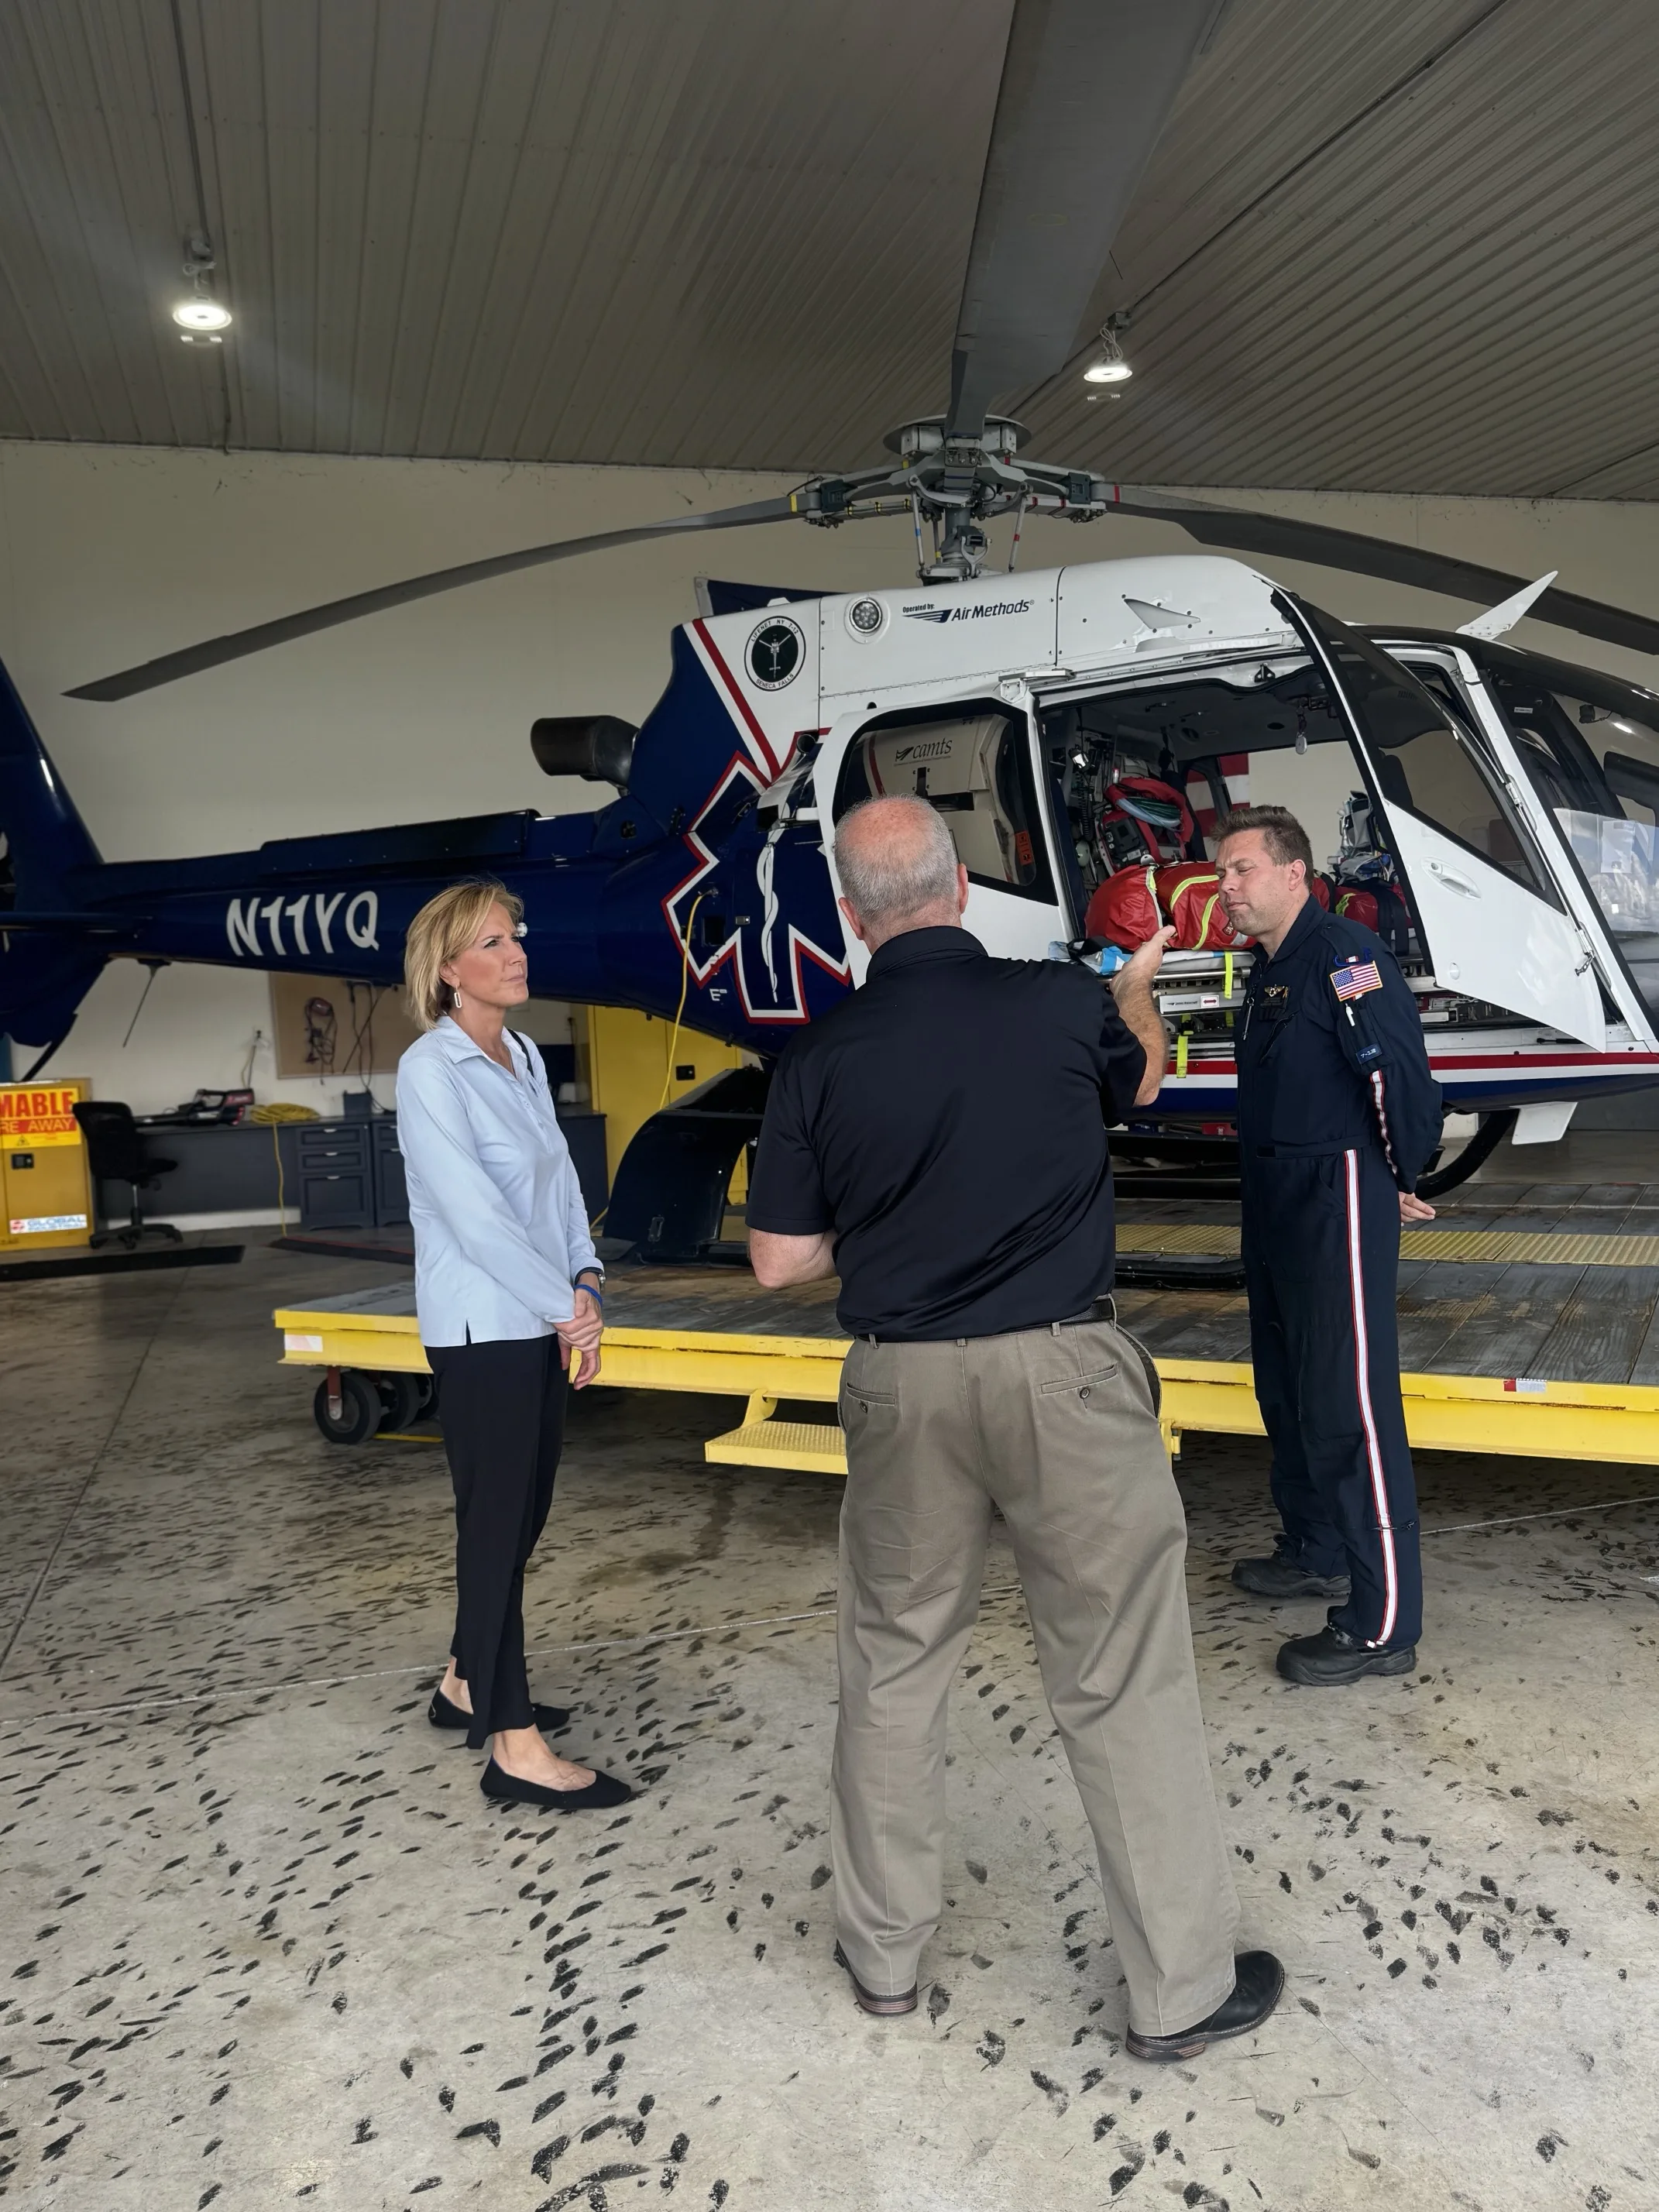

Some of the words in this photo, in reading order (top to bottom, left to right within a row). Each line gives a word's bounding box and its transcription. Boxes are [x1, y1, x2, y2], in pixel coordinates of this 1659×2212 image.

[902, 604, 926, 613] Operated
[750, 620, 771, 642] LIFENET
[788, 623, 799, 634] 7-12
[756, 678, 776, 689] SENECA
[778, 673, 794, 687] FALLS
[912, 737, 953, 759] camts
[226, 891, 380, 957] N11YQ
[28, 1118, 73, 1132] AWAY
